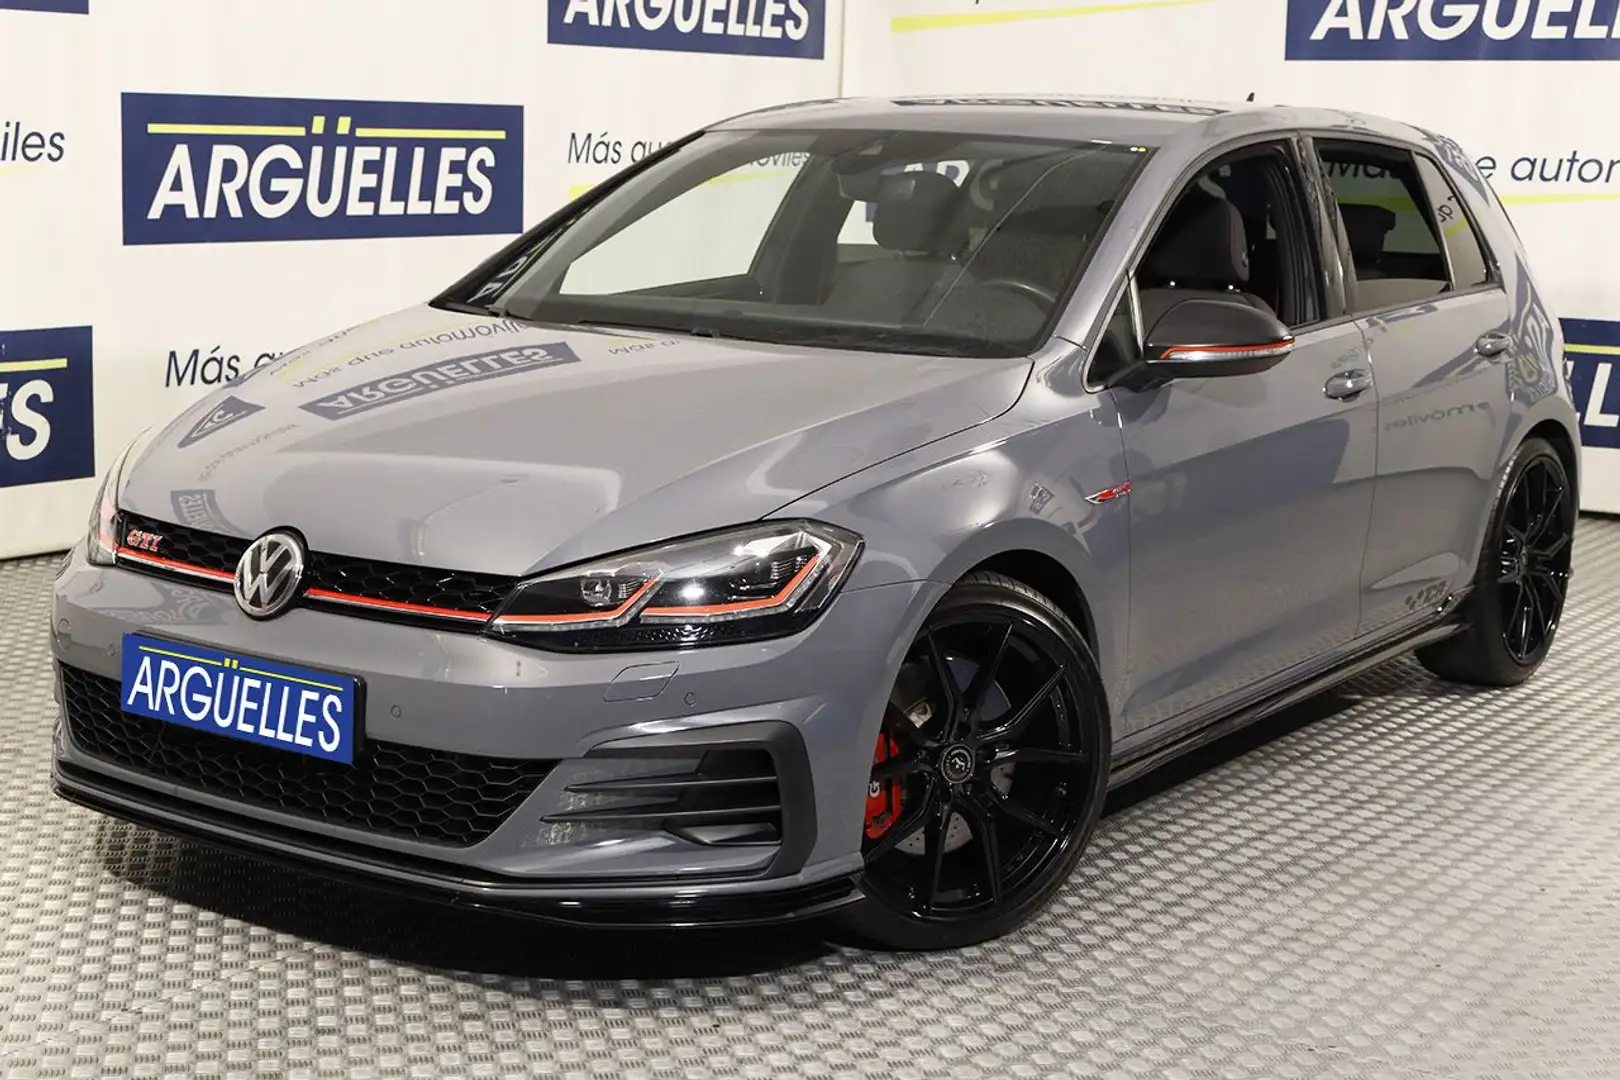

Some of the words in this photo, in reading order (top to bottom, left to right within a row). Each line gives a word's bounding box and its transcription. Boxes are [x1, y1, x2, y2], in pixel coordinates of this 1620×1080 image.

[147, 116, 495, 220] ARGÜELLES
[568, 132, 622, 165] Más
[165, 345, 241, 388] Más
[127, 529, 163, 552] GTI
[127, 655, 342, 752] ARGÜELLES
